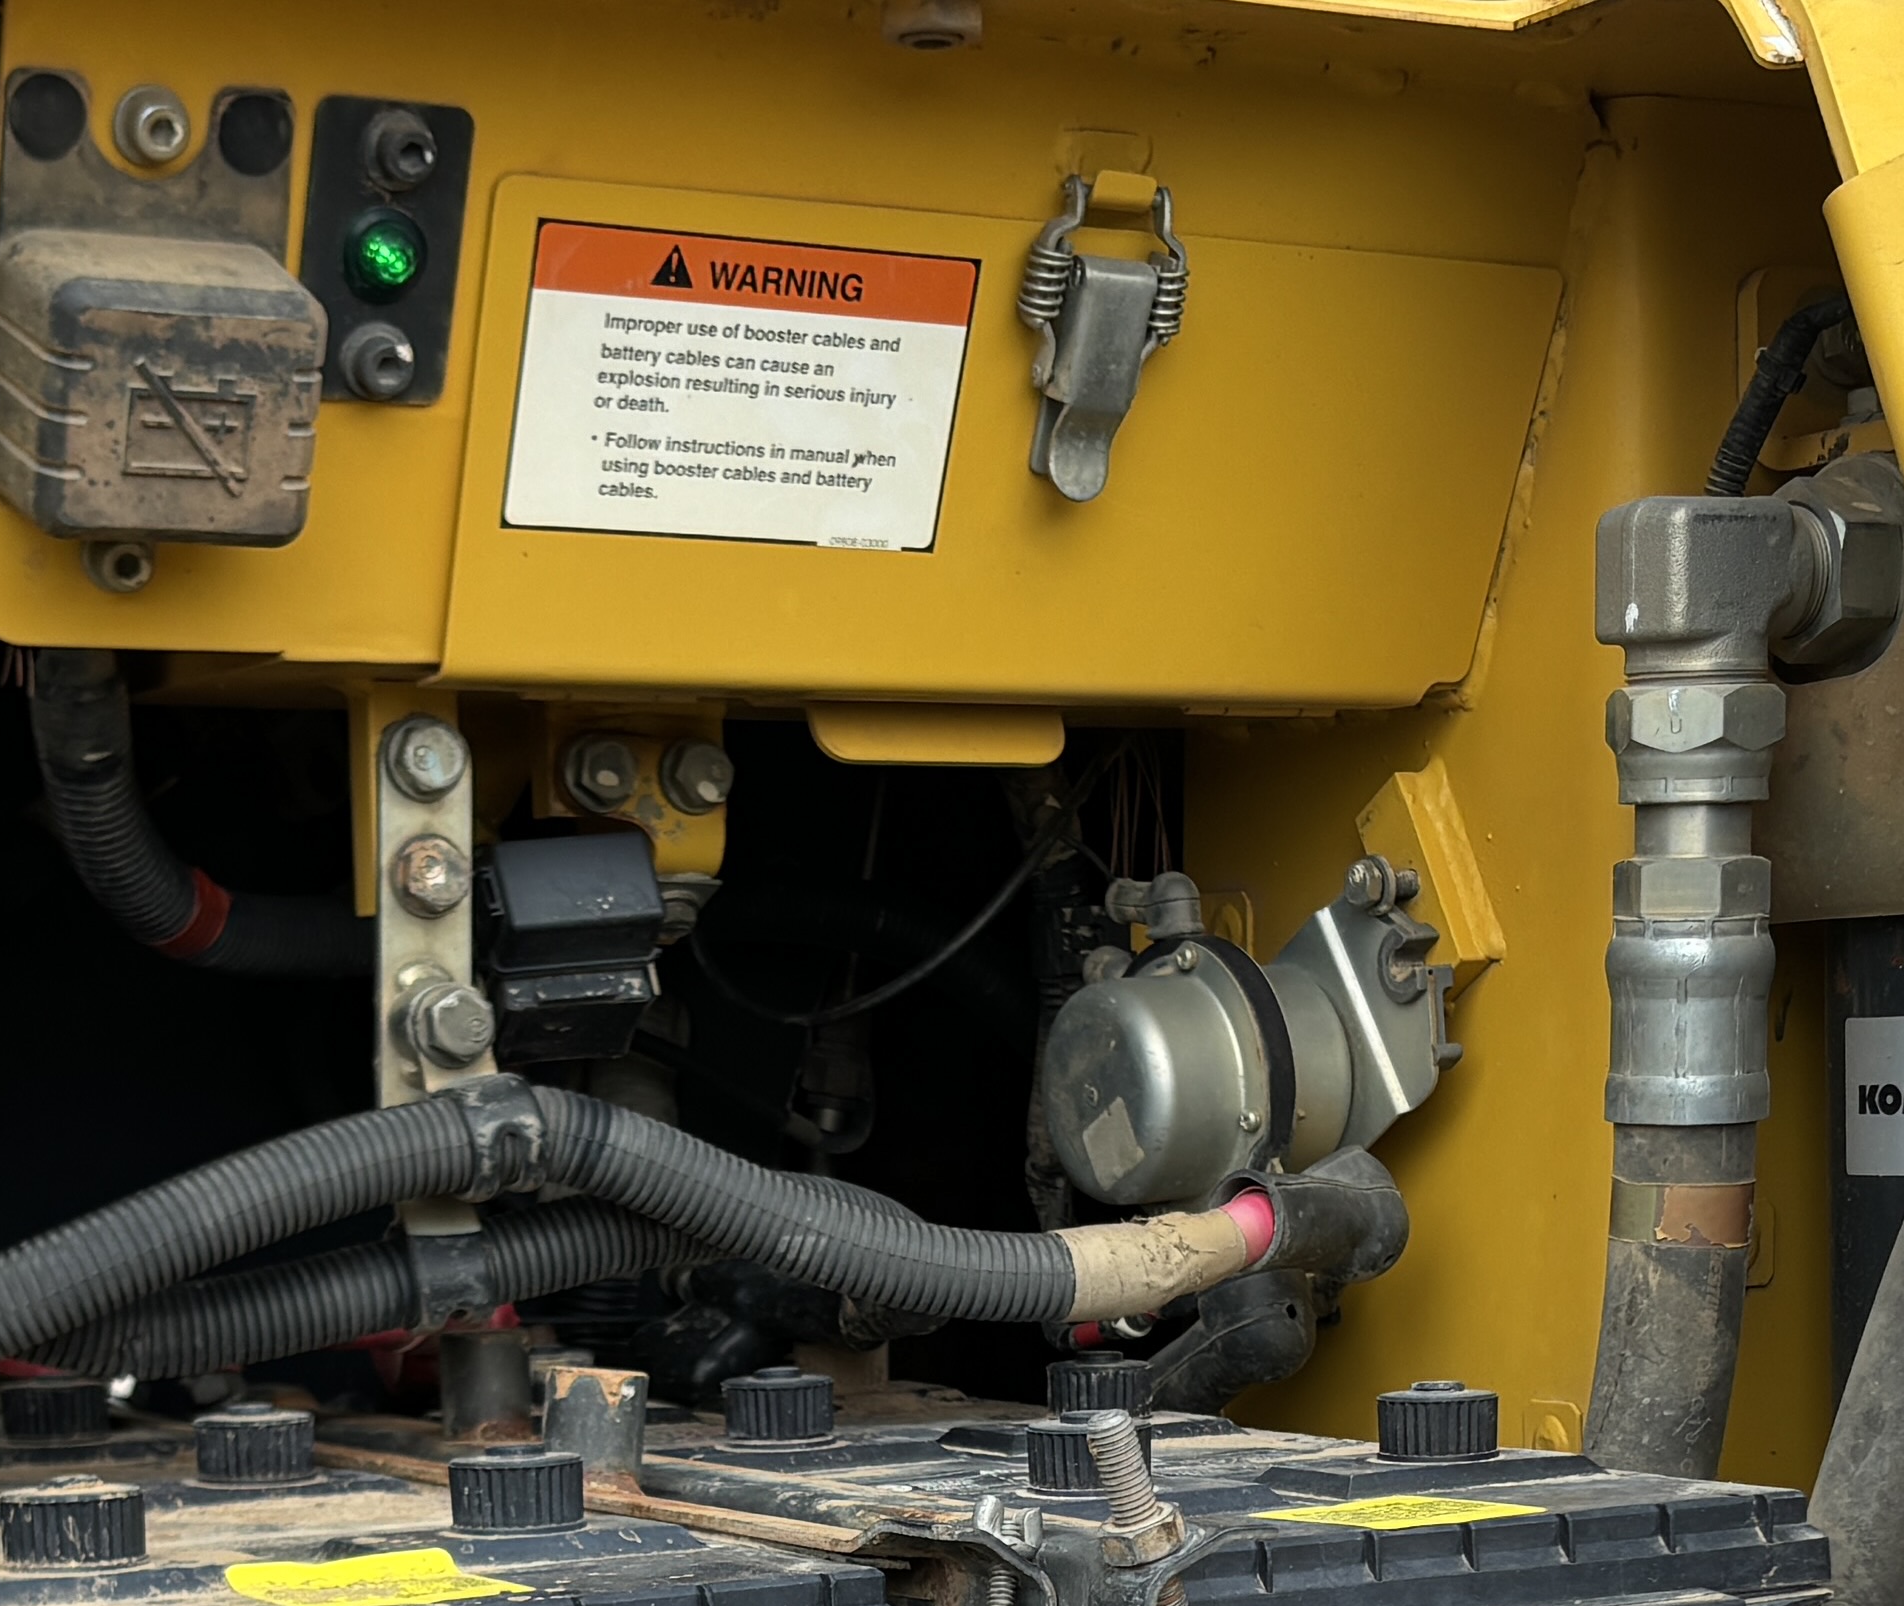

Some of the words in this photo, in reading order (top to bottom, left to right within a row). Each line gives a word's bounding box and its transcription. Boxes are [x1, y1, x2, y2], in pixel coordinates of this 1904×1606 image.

[709, 260, 865, 303] WARNING
[604, 312, 682, 336] Improper
[687, 321, 718, 337] use
[722, 322, 741, 338] of
[743, 324, 809, 345] booster
[812, 331, 865, 350] cables
[870, 337, 901, 353] and
[600, 343, 661, 367] battery
[665, 349, 720, 368] cables
[725, 355, 756, 371] can
[760, 359, 809, 375] cause
[813, 362, 835, 377] an
[593, 395, 613, 409] or
[616, 394, 670, 413] death.
[597, 368, 681, 390] explosion
[685, 377, 760, 398] resulting
[764, 380, 780, 396] in
[784, 384, 846, 402] serious
[849, 387, 897, 409] injury
[604, 431, 662, 451] Follow
[665, 436, 766, 458] instructions
[770, 444, 786, 460] in
[789, 448, 850, 465] manual
[852, 450, 896, 468] when
[598, 481, 659, 499] cables.
[601, 457, 649, 478] using
[653, 460, 720, 480] booster
[722, 465, 776, 484] cables
[780, 470, 812, 485] and
[815, 471, 873, 493] battery
